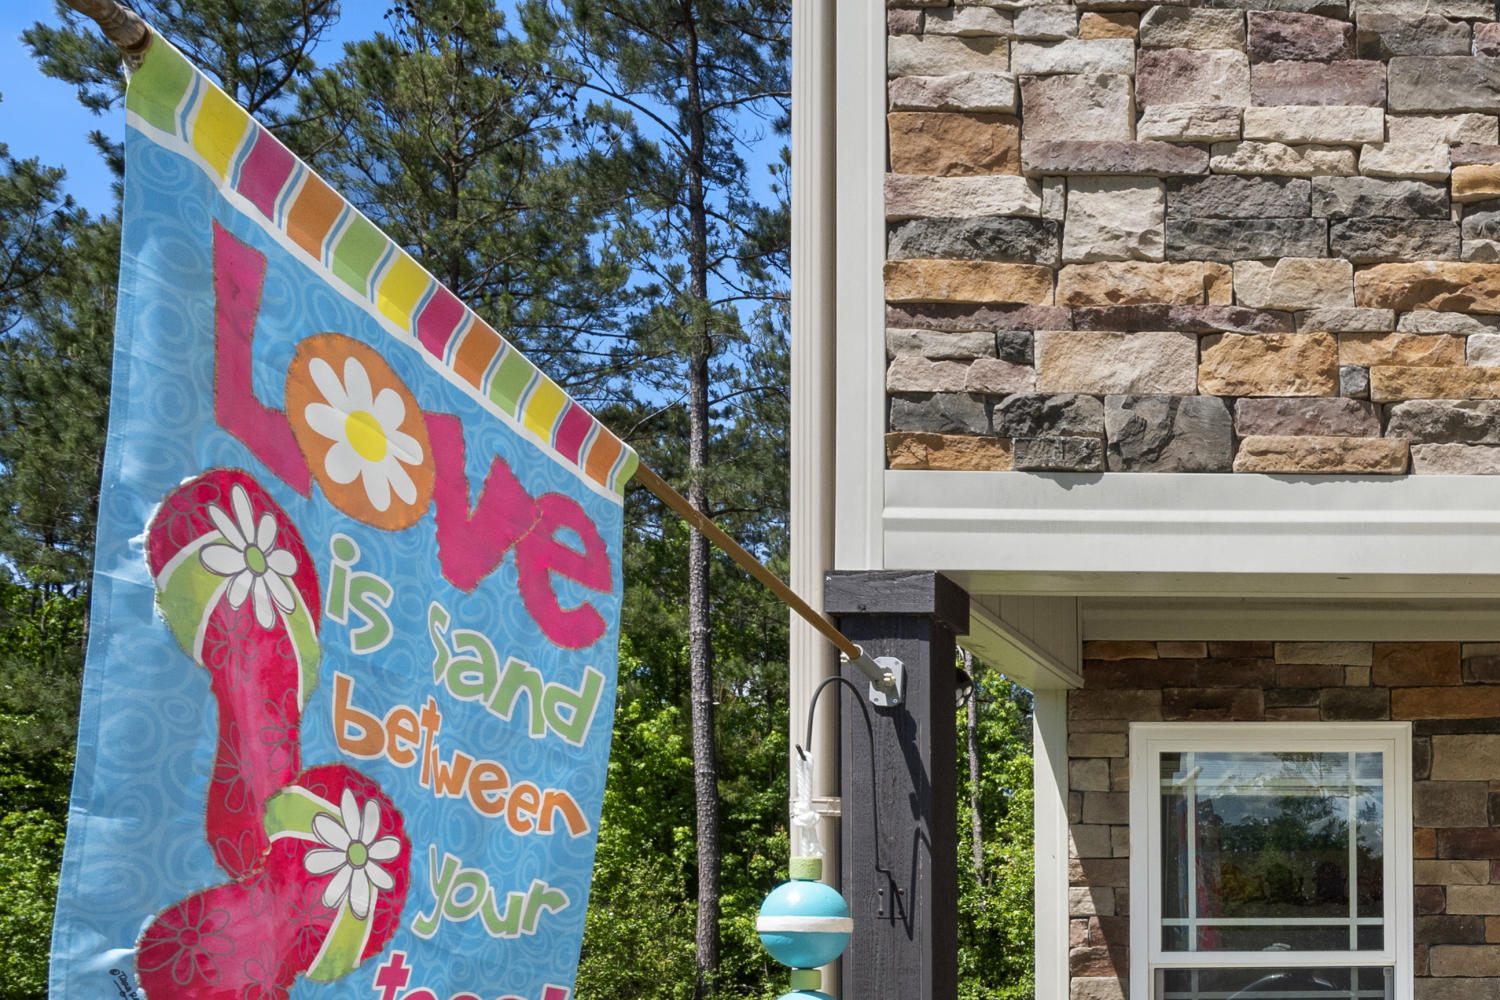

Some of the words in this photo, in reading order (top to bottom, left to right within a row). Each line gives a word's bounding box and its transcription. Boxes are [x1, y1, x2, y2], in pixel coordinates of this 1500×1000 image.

[326, 533, 394, 654] is
[332, 670, 591, 838] between
[411, 844, 570, 939] your
